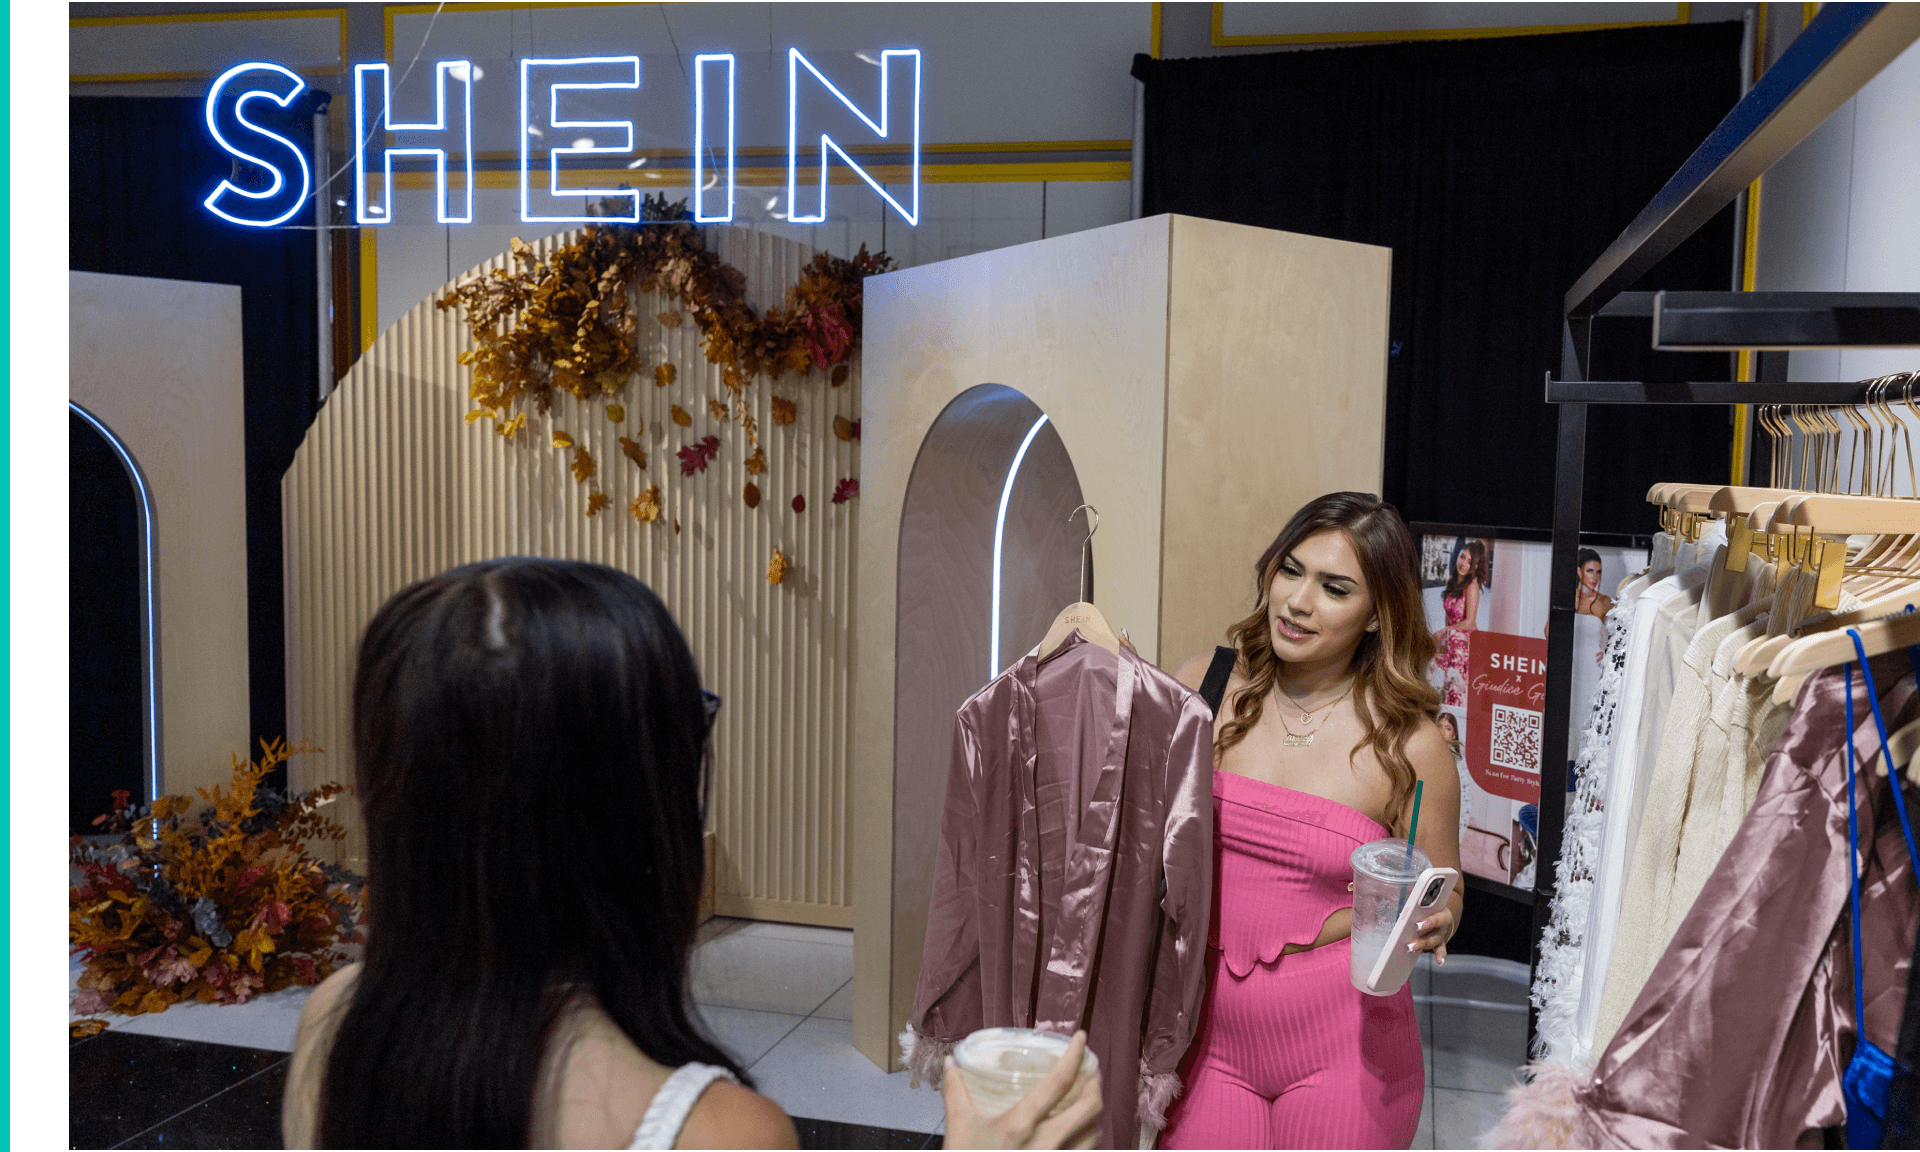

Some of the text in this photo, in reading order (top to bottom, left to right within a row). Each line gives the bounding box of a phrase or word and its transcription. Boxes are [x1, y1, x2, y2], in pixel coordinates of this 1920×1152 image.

[203, 47, 922, 227] SHEIN
[1064, 615, 1091, 624] SHEIN
[1472, 673, 1523, 696] Giudice
